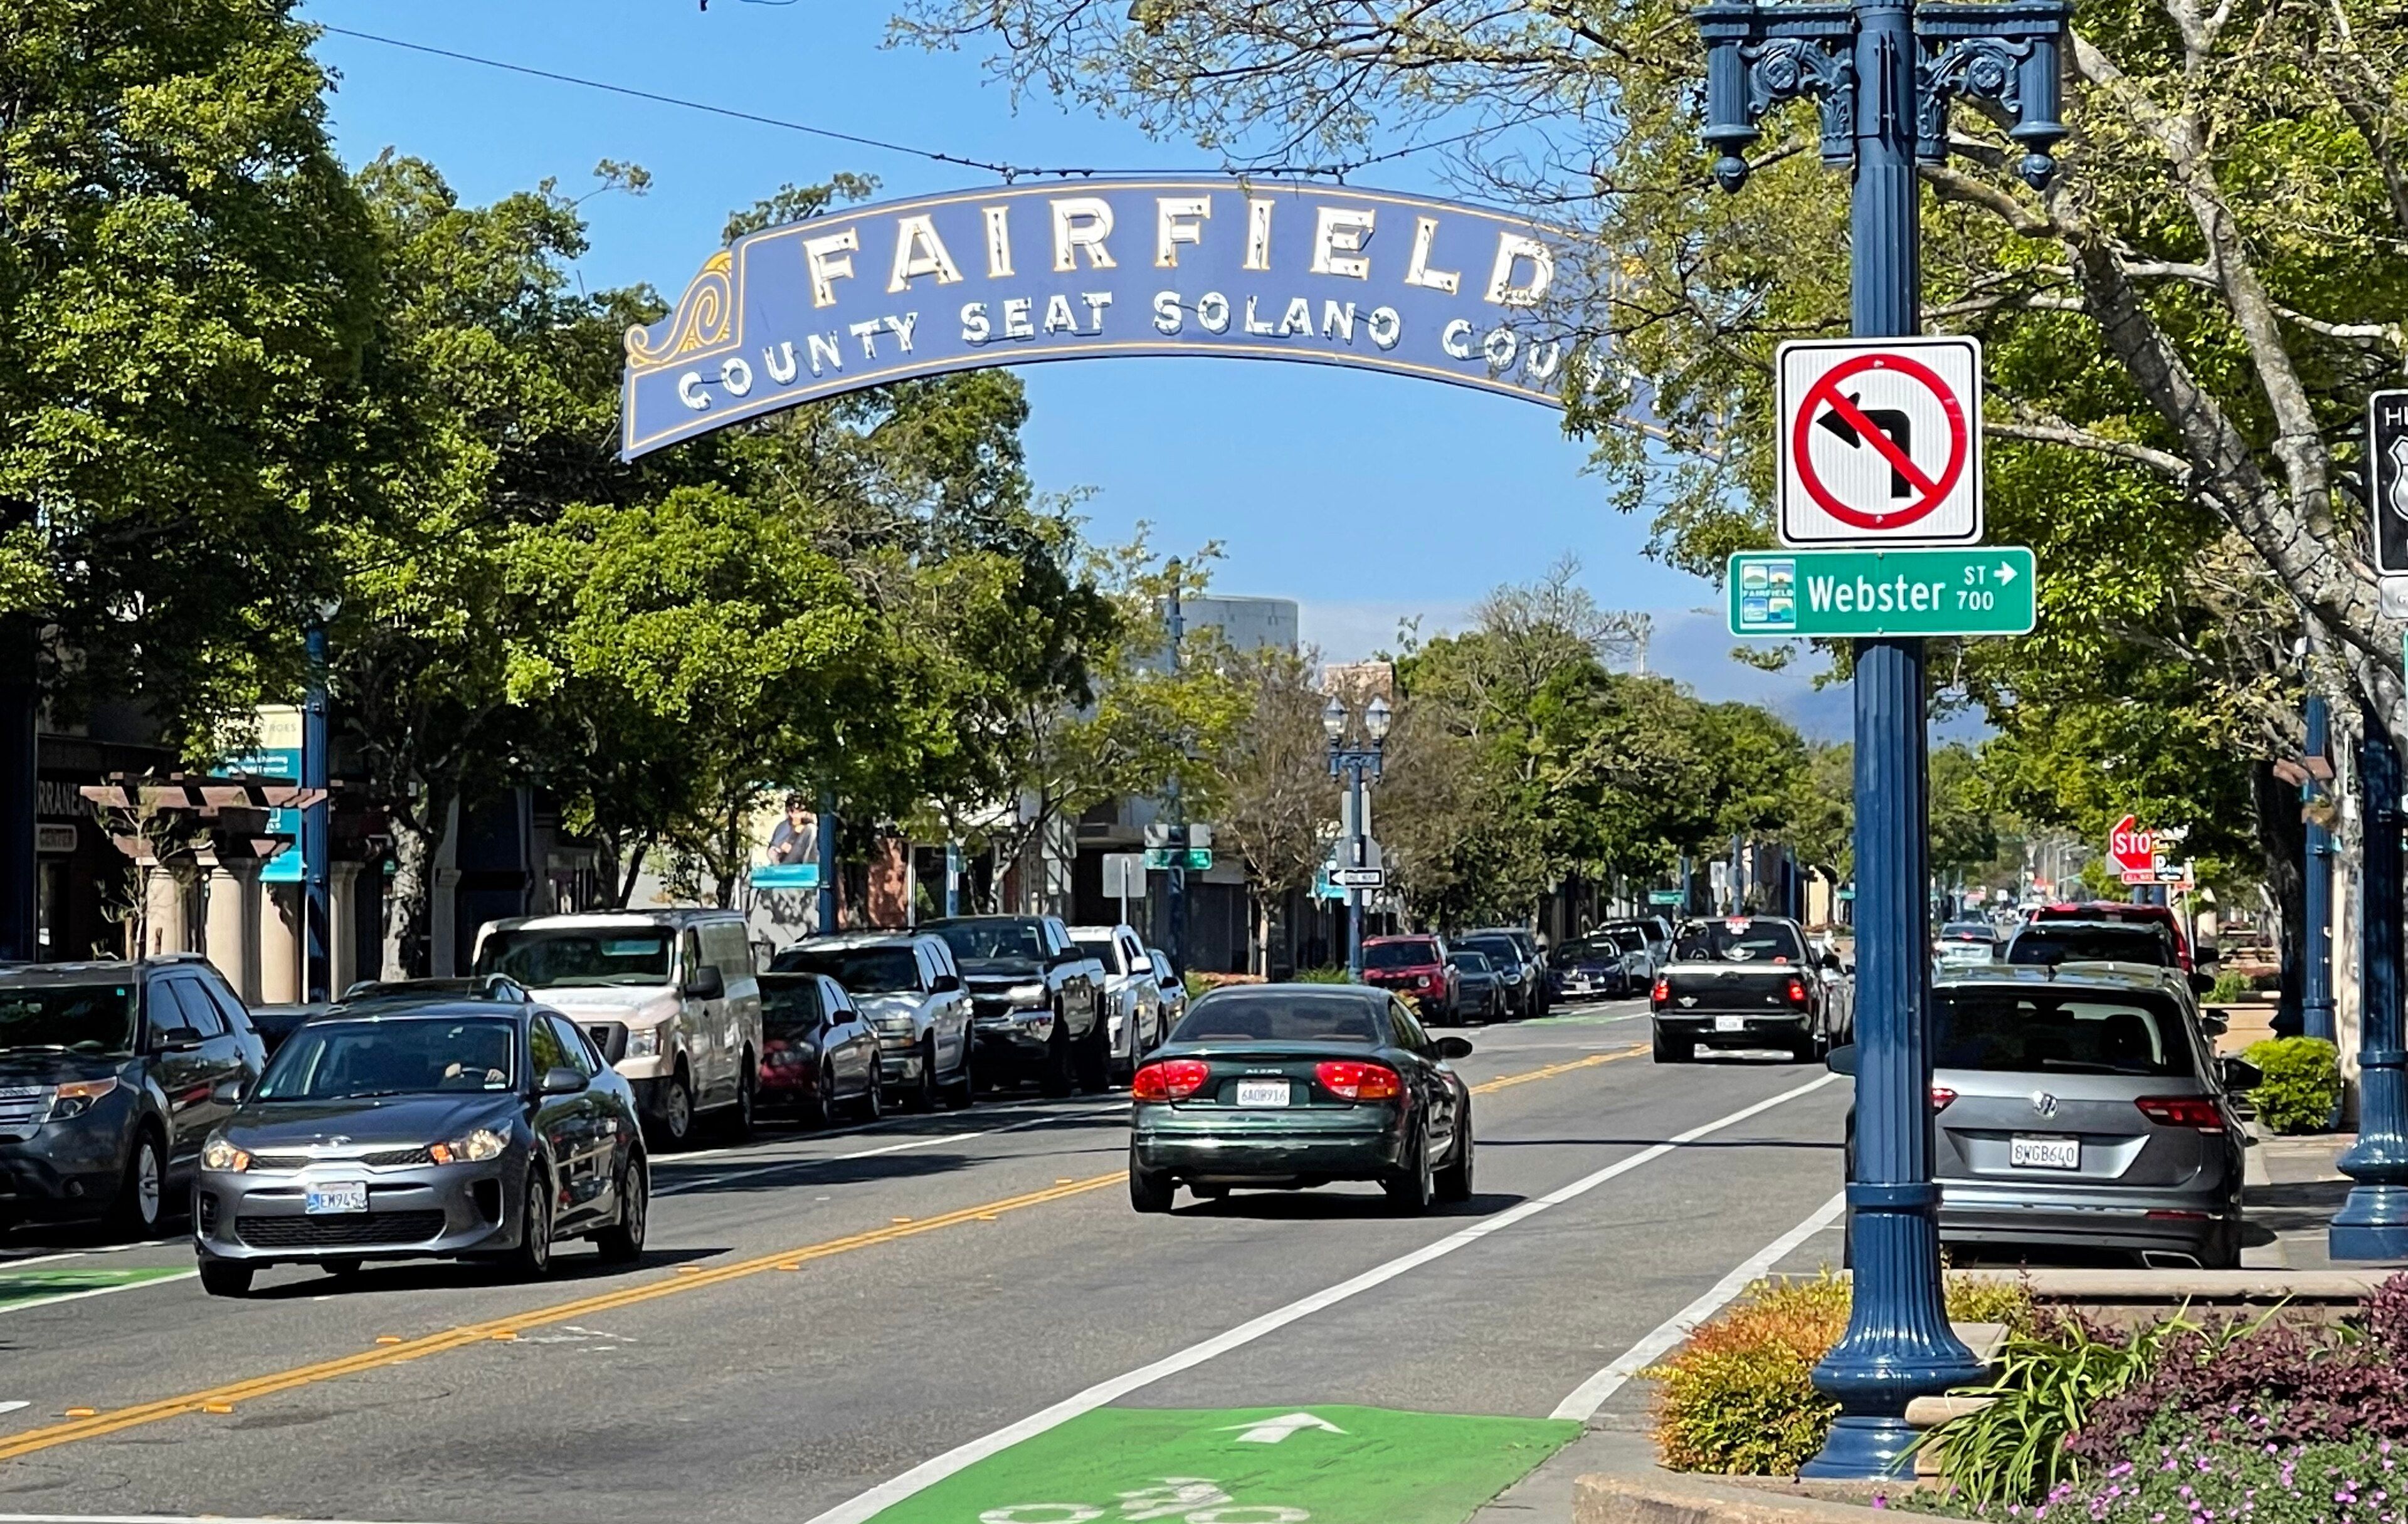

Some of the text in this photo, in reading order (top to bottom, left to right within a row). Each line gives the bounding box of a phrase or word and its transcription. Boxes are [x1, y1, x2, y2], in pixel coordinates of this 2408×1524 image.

[803, 195, 1556, 308] FAIRFIELD
[679, 312, 919, 411] COUNTY
[961, 292, 1113, 343] SEAT
[1153, 290, 1401, 350] SOLANO
[1743, 589, 1794, 597] FAIRFIELD
[1807, 565, 1987, 612] Webster ST
[1956, 591, 1995, 611] 700
[2115, 832, 2152, 855] STO
[2015, 1144, 2074, 1163] 8WGB640
